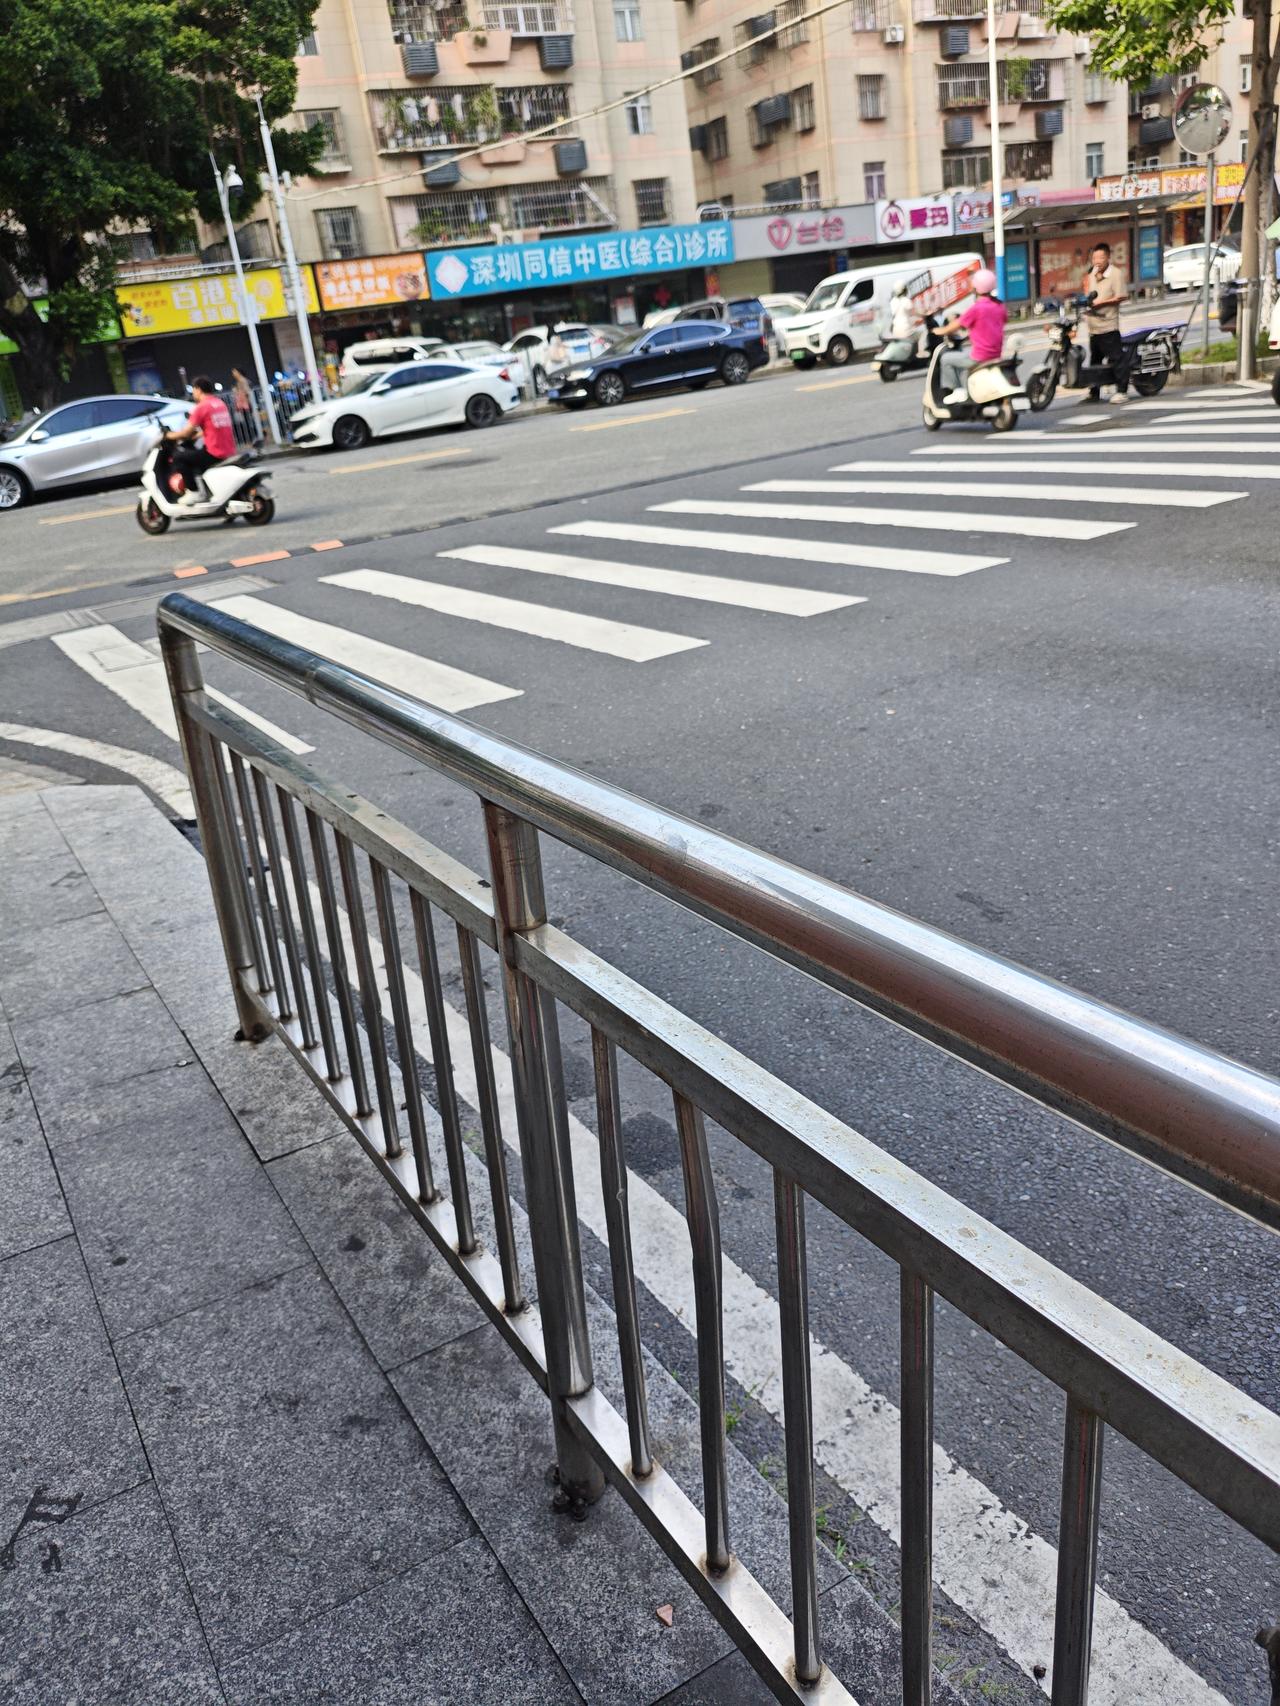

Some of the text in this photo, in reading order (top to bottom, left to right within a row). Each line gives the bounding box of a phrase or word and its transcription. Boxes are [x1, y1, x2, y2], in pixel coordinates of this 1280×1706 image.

[470, 227, 729, 286] 深圳同信中医(综合)诊所
